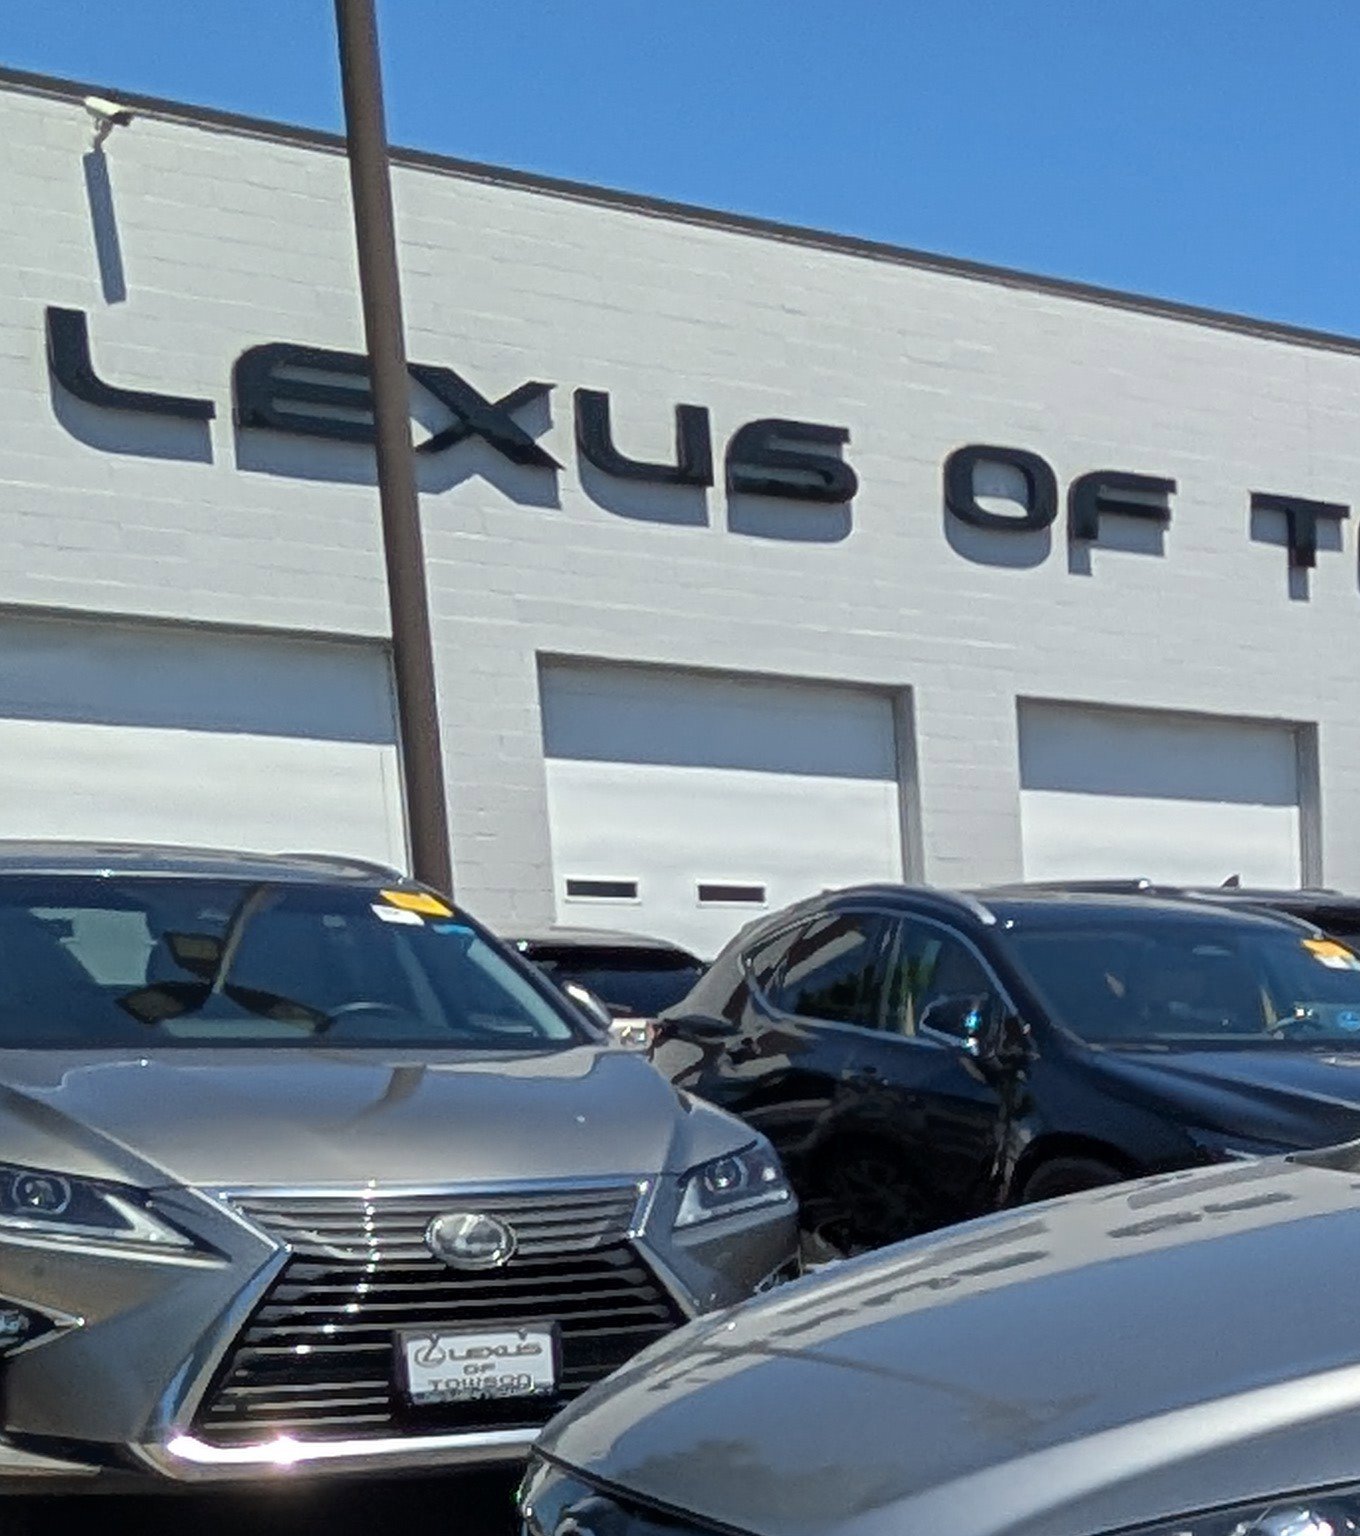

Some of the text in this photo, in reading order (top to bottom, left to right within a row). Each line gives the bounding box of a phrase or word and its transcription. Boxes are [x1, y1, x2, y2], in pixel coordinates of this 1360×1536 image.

[45, 306, 858, 504] LEXUS
[943, 443, 1177, 542] OF
[449, 1342, 542, 1361] LEXUS
[463, 1363, 496, 1376] OF
